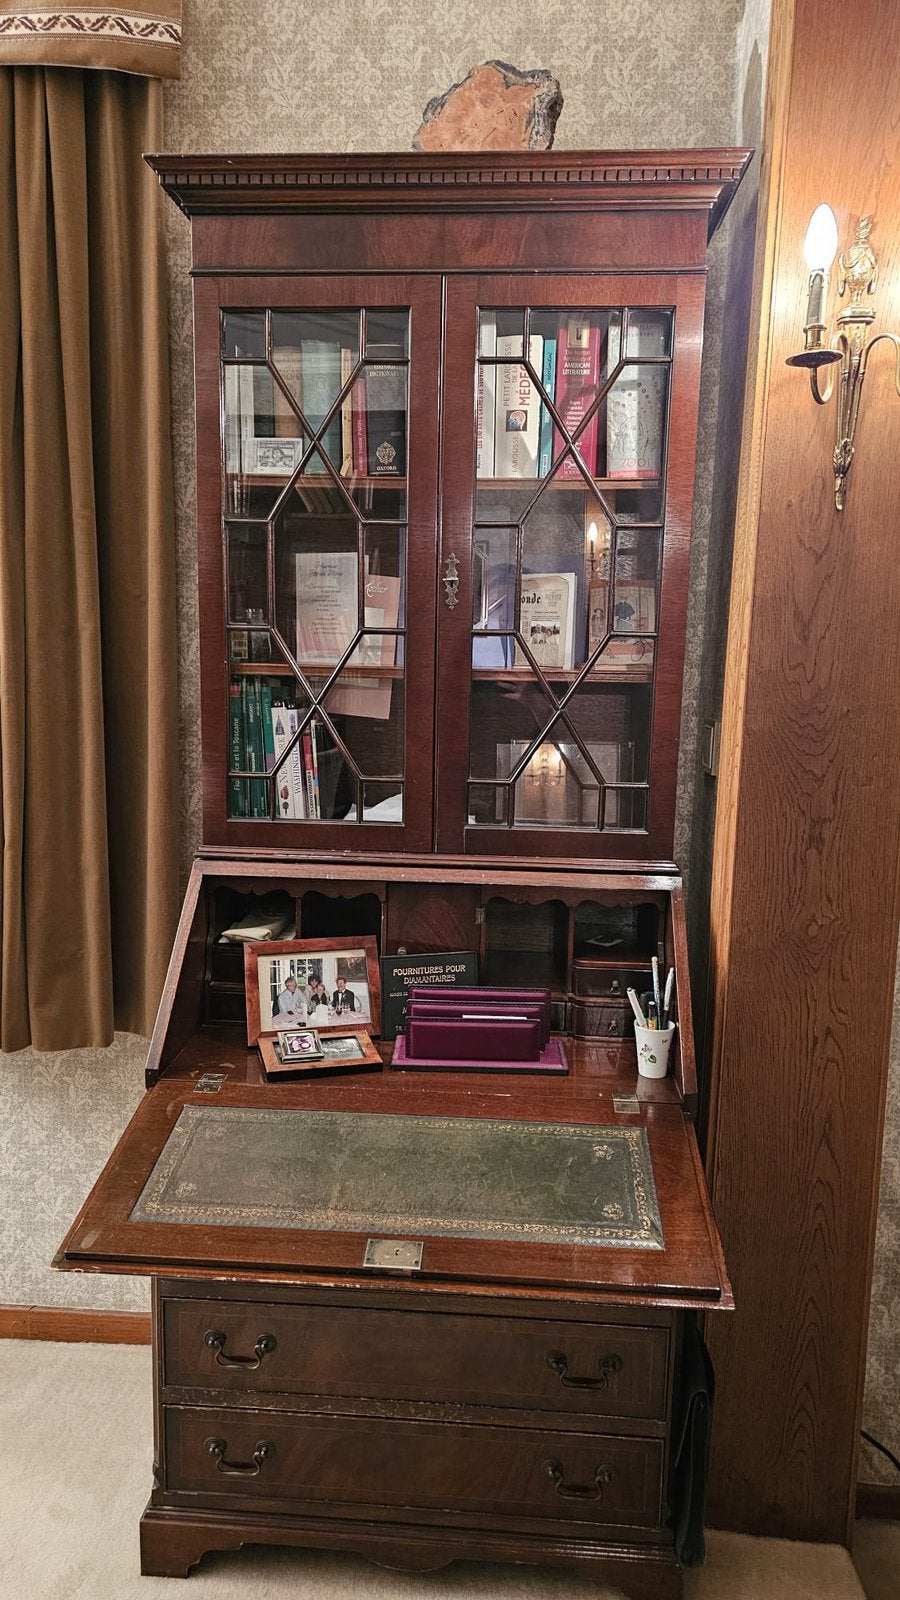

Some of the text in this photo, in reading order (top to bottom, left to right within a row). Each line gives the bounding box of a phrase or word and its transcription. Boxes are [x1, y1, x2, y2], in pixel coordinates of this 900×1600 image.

[504, 341, 512, 383] LAROSSE
[511, 365, 518, 384] DE LA
[511, 435, 519, 473] LAROUSSE
[621, 457, 650, 467] 2001
[521, 592, 541, 604] onde
[233, 753, 240, 761] et
[291, 742, 301, 794] WASHINGTO
[393, 964, 466, 976] FOURNITURES POUR
[403, 974, 456, 984] DIAMANTAIRES
